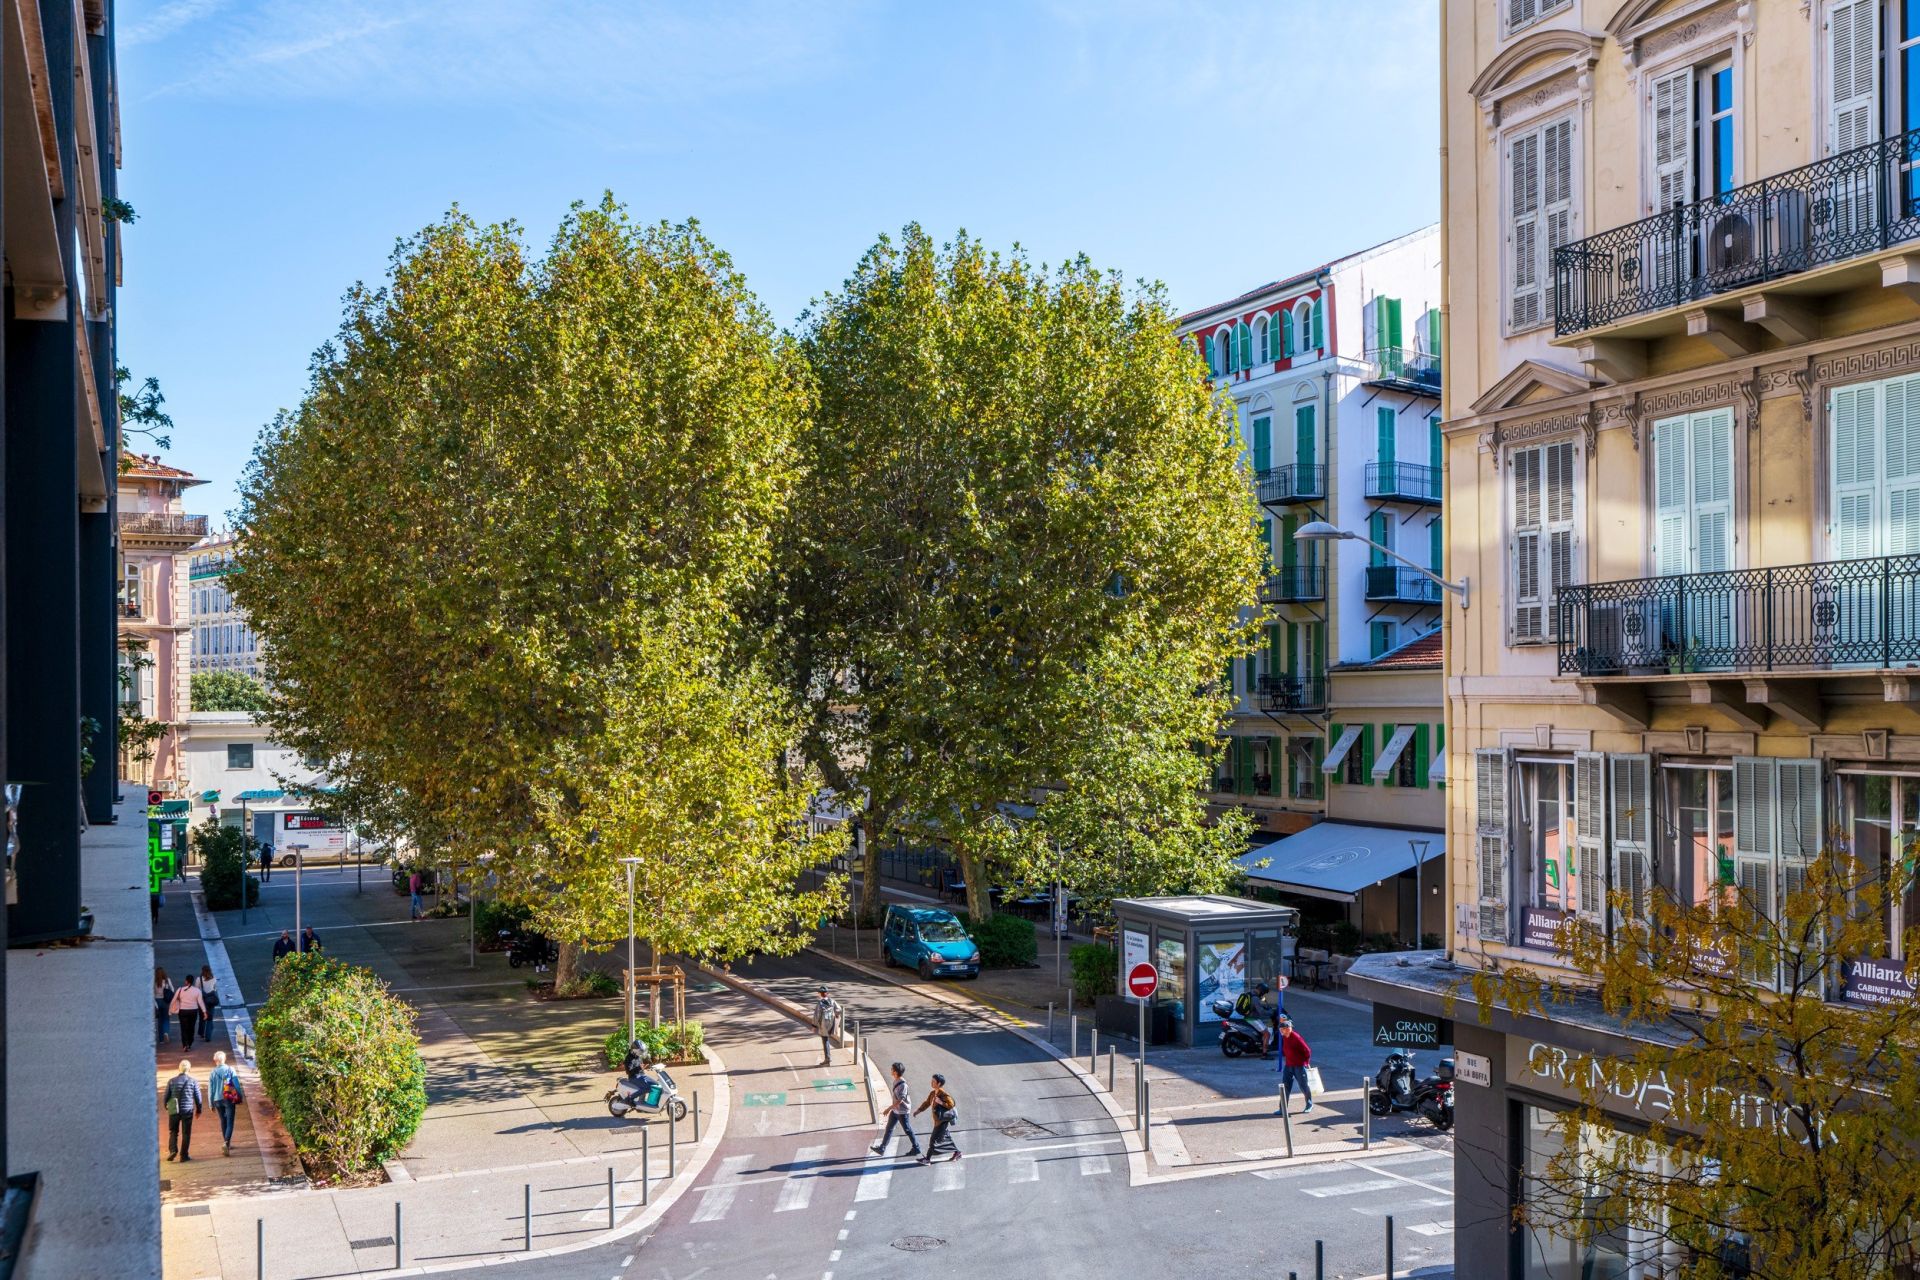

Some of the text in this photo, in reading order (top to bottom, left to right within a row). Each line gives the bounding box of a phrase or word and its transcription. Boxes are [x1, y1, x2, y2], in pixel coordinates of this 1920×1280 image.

[1528, 913, 1561, 929] Allianz
[1851, 961, 1903, 983] Allianz
[1857, 983, 1889, 995] CABINET
[1396, 1020, 1437, 1033] GRAND
[1375, 1026, 1437, 1044] AUDITION
[1467, 1058, 1477, 1067] RUE
[1463, 1069, 1471, 1077] LA
[1471, 1070, 1488, 1082] BUFFA
